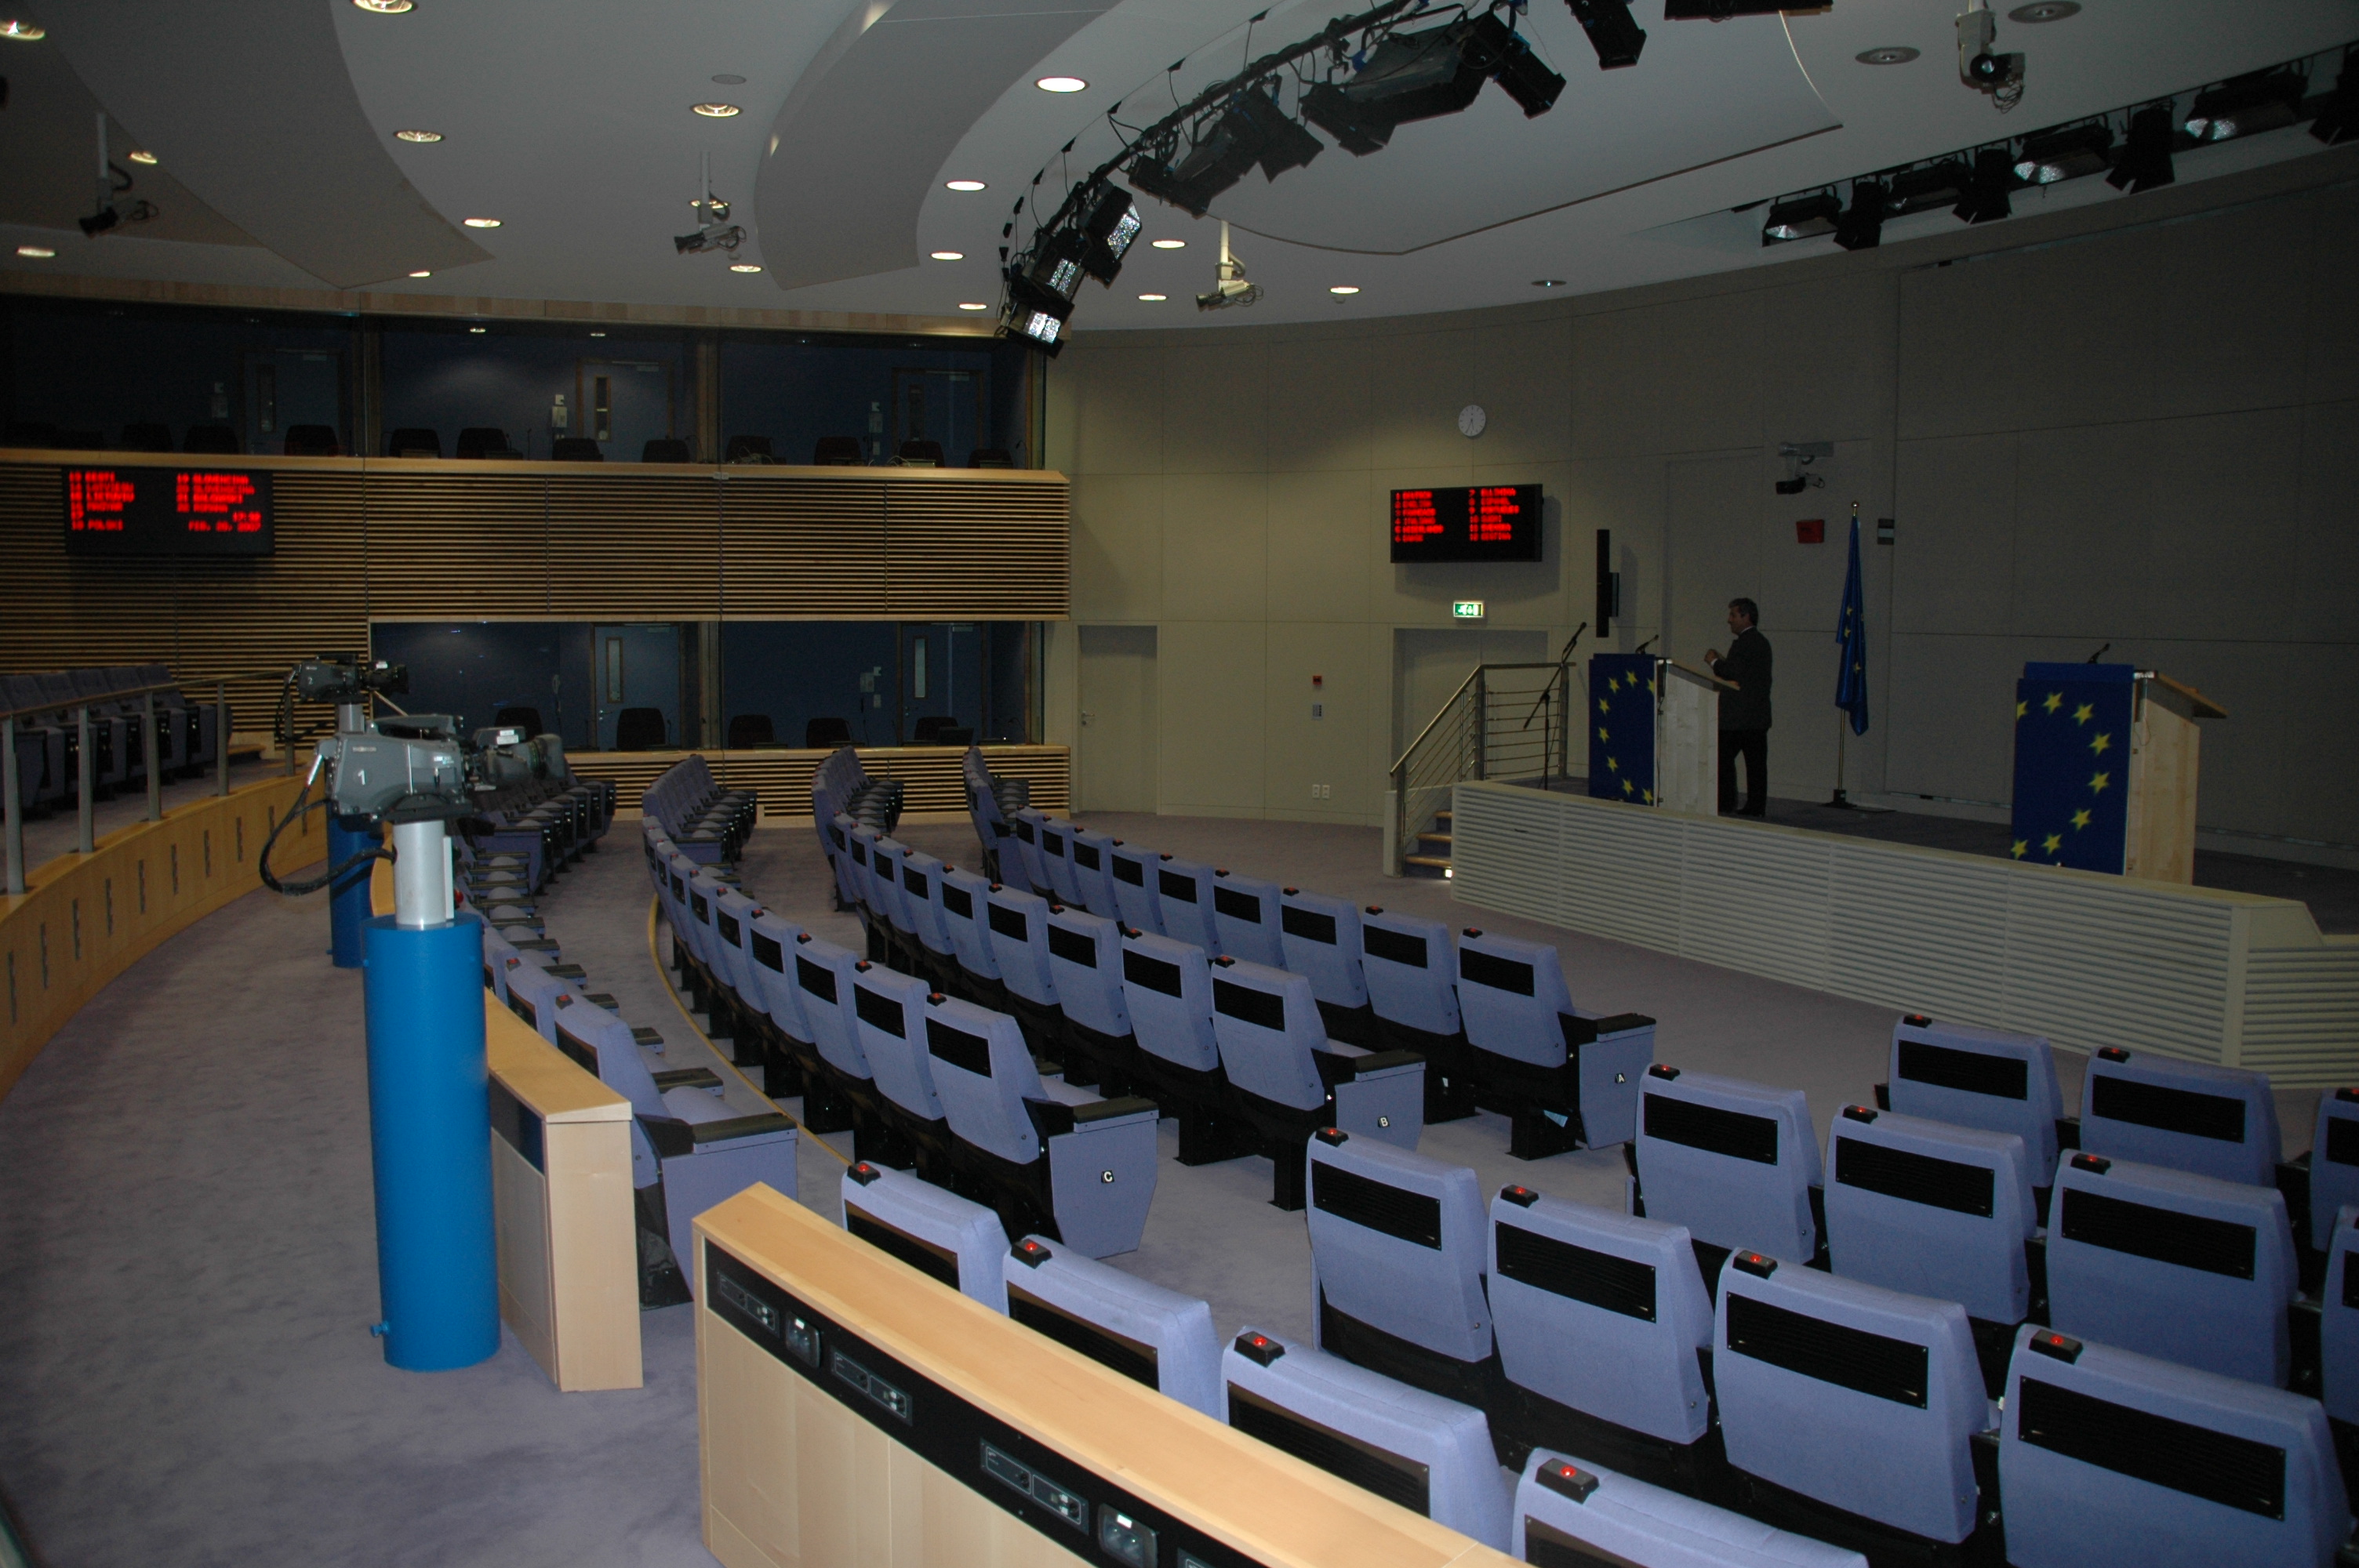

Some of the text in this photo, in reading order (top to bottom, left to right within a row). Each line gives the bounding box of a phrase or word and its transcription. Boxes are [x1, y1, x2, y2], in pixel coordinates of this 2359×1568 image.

[358, 769, 365, 786] 1
[1618, 1073, 1626, 1083] A
[1380, 1116, 1388, 1127] B
[1103, 1171, 1113, 1182] C
